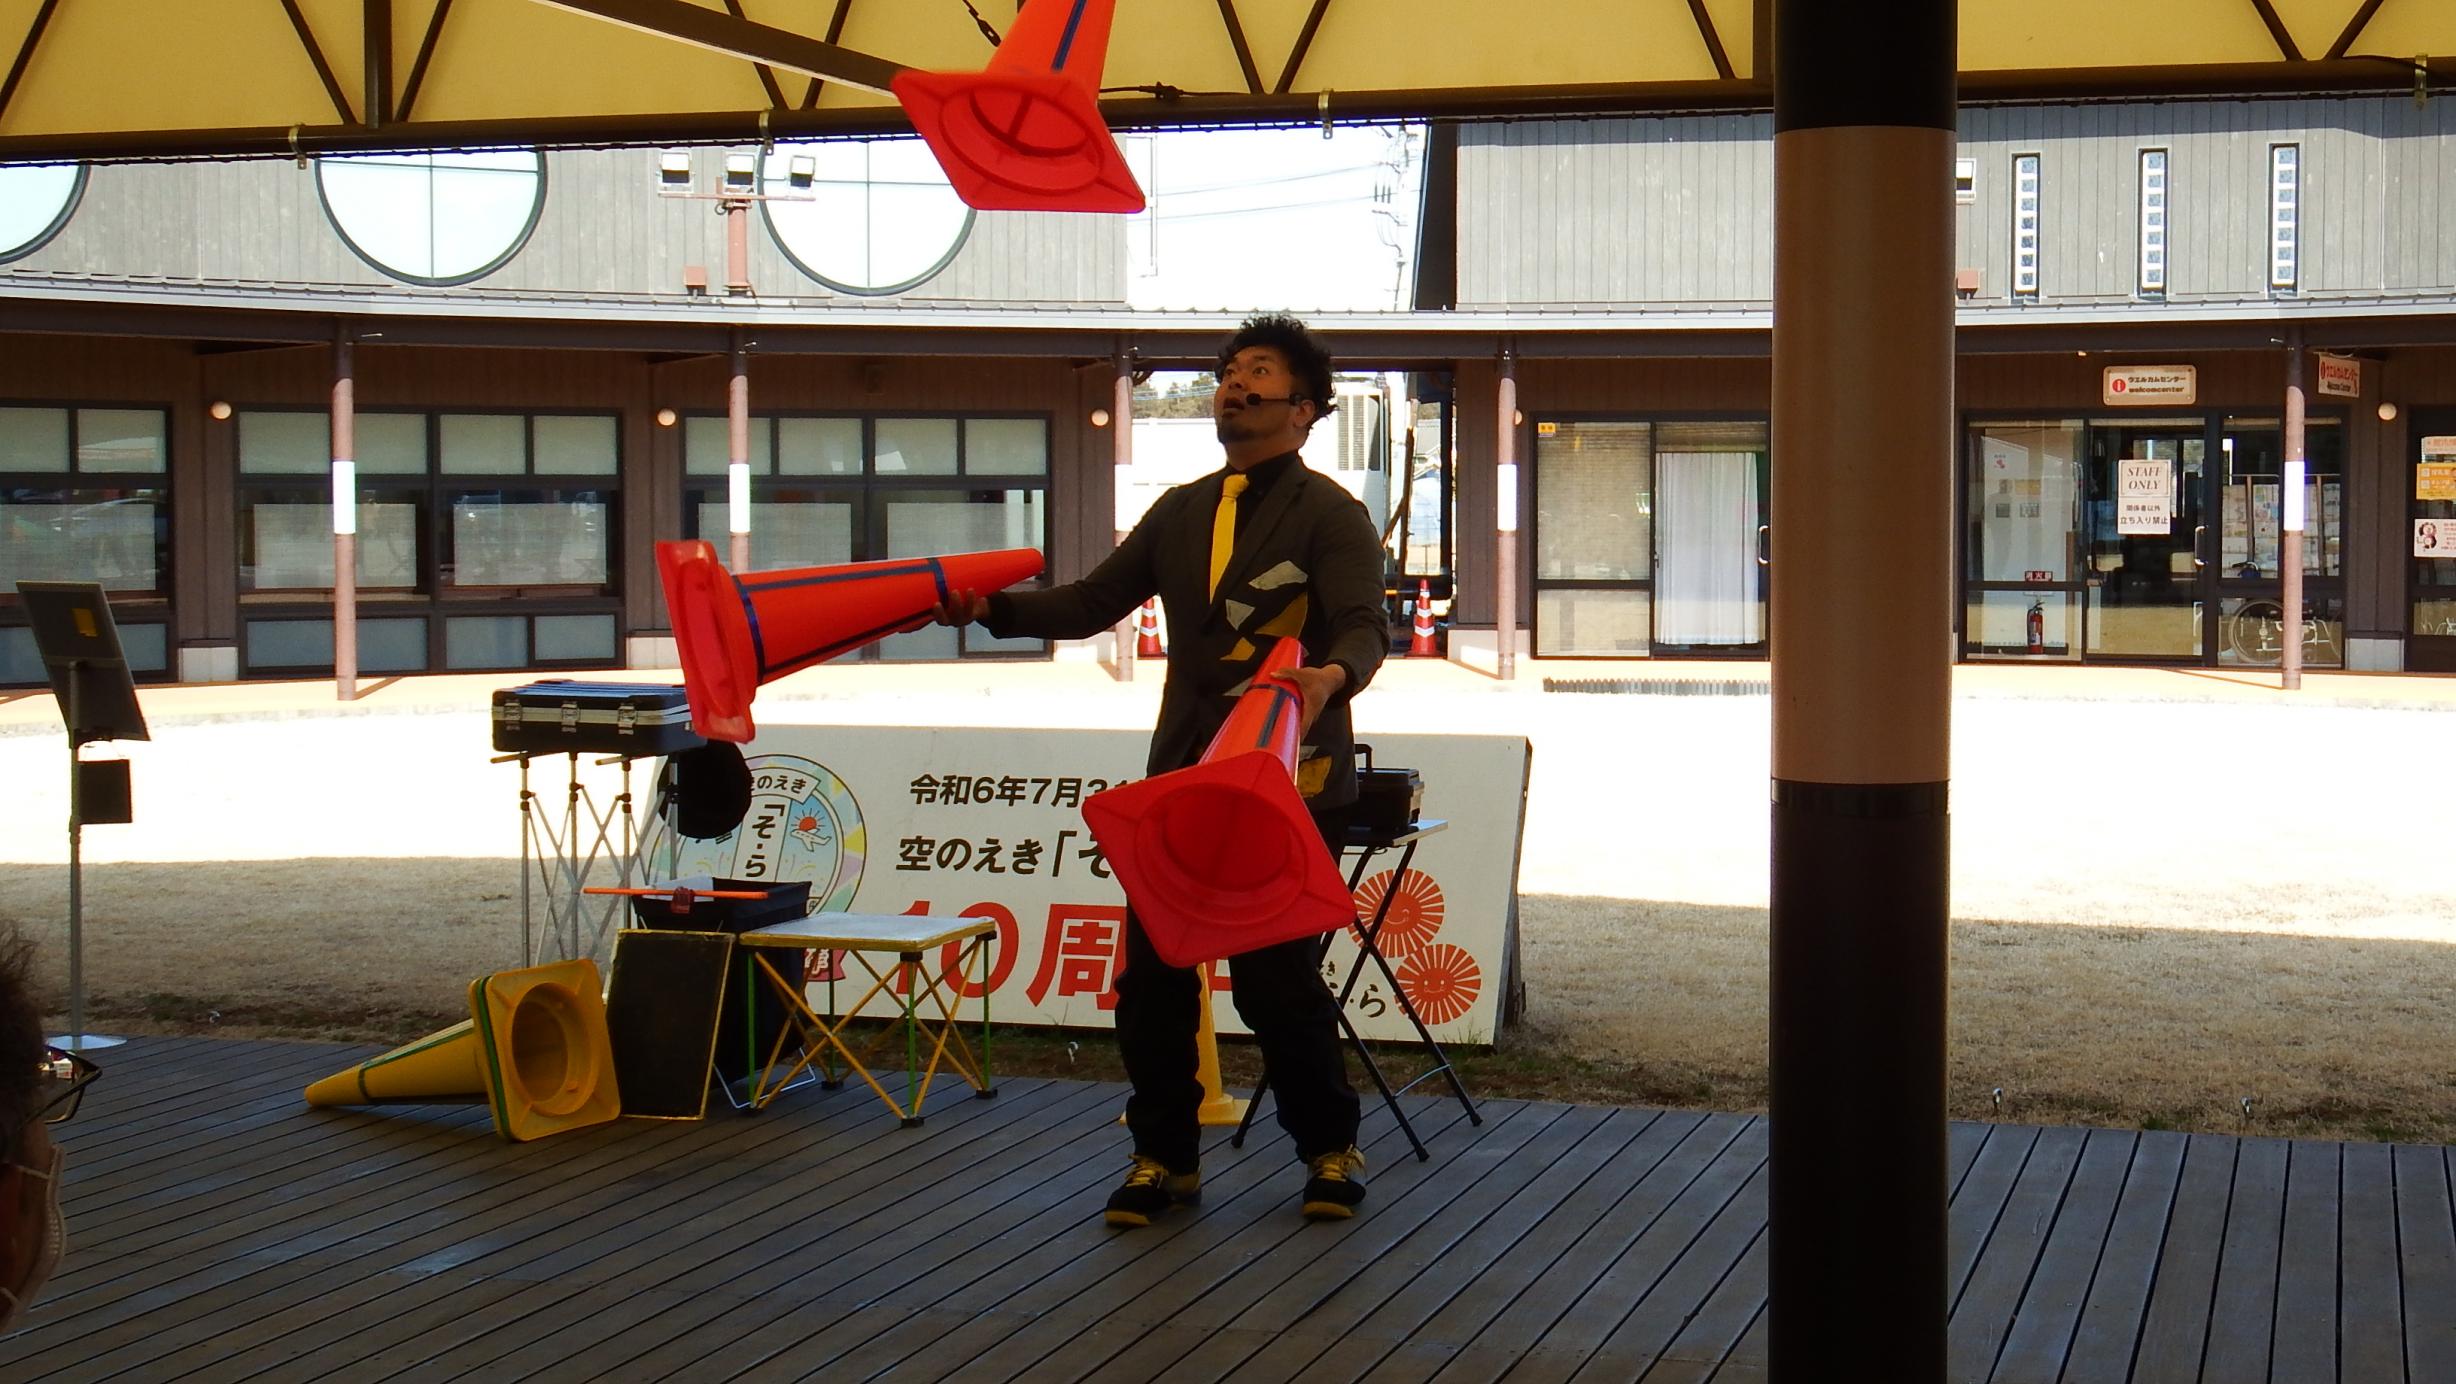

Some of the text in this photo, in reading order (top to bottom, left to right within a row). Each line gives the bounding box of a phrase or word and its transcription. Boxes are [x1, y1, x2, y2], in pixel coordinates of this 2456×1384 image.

[2128, 467, 2160, 477] STAFF
[2128, 480, 2160, 490] ONLY
[2120, 516, 2168, 525] 立ち入り禁止
[910, 774, 1127, 808] 令和6年7月3
